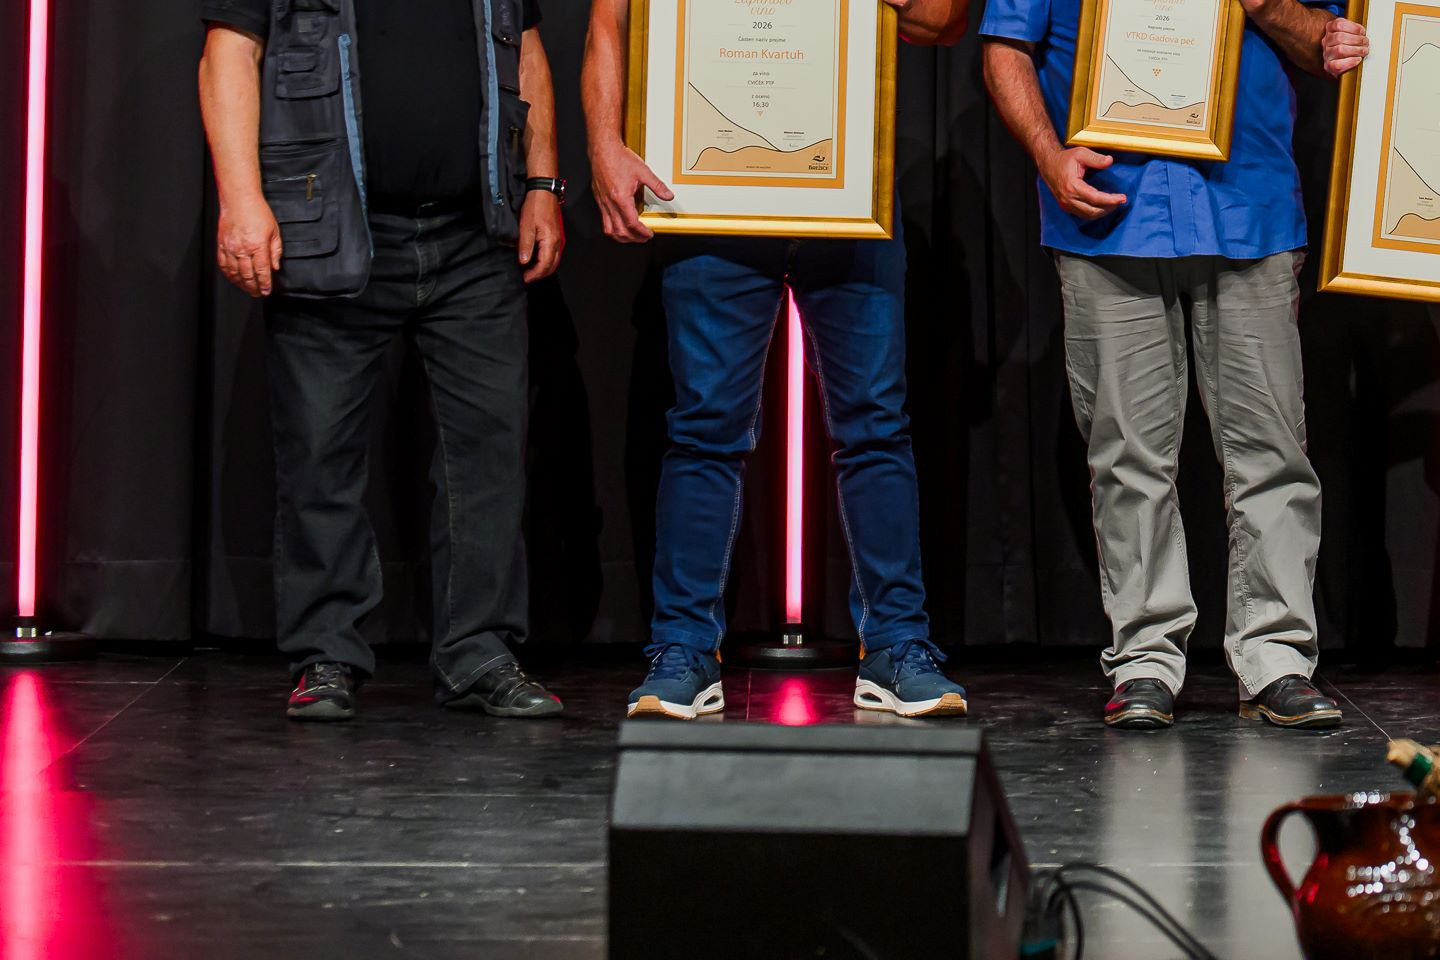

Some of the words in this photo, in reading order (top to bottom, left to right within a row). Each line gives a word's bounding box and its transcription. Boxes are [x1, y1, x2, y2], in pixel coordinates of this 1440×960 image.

[750, 7, 776, 15] vino
[1126, 32, 1147, 40] VTKD
[1149, 34, 1178, 43] Gadova
[720, 48, 758, 58] Roman
[761, 49, 804, 60] Kvartuh
